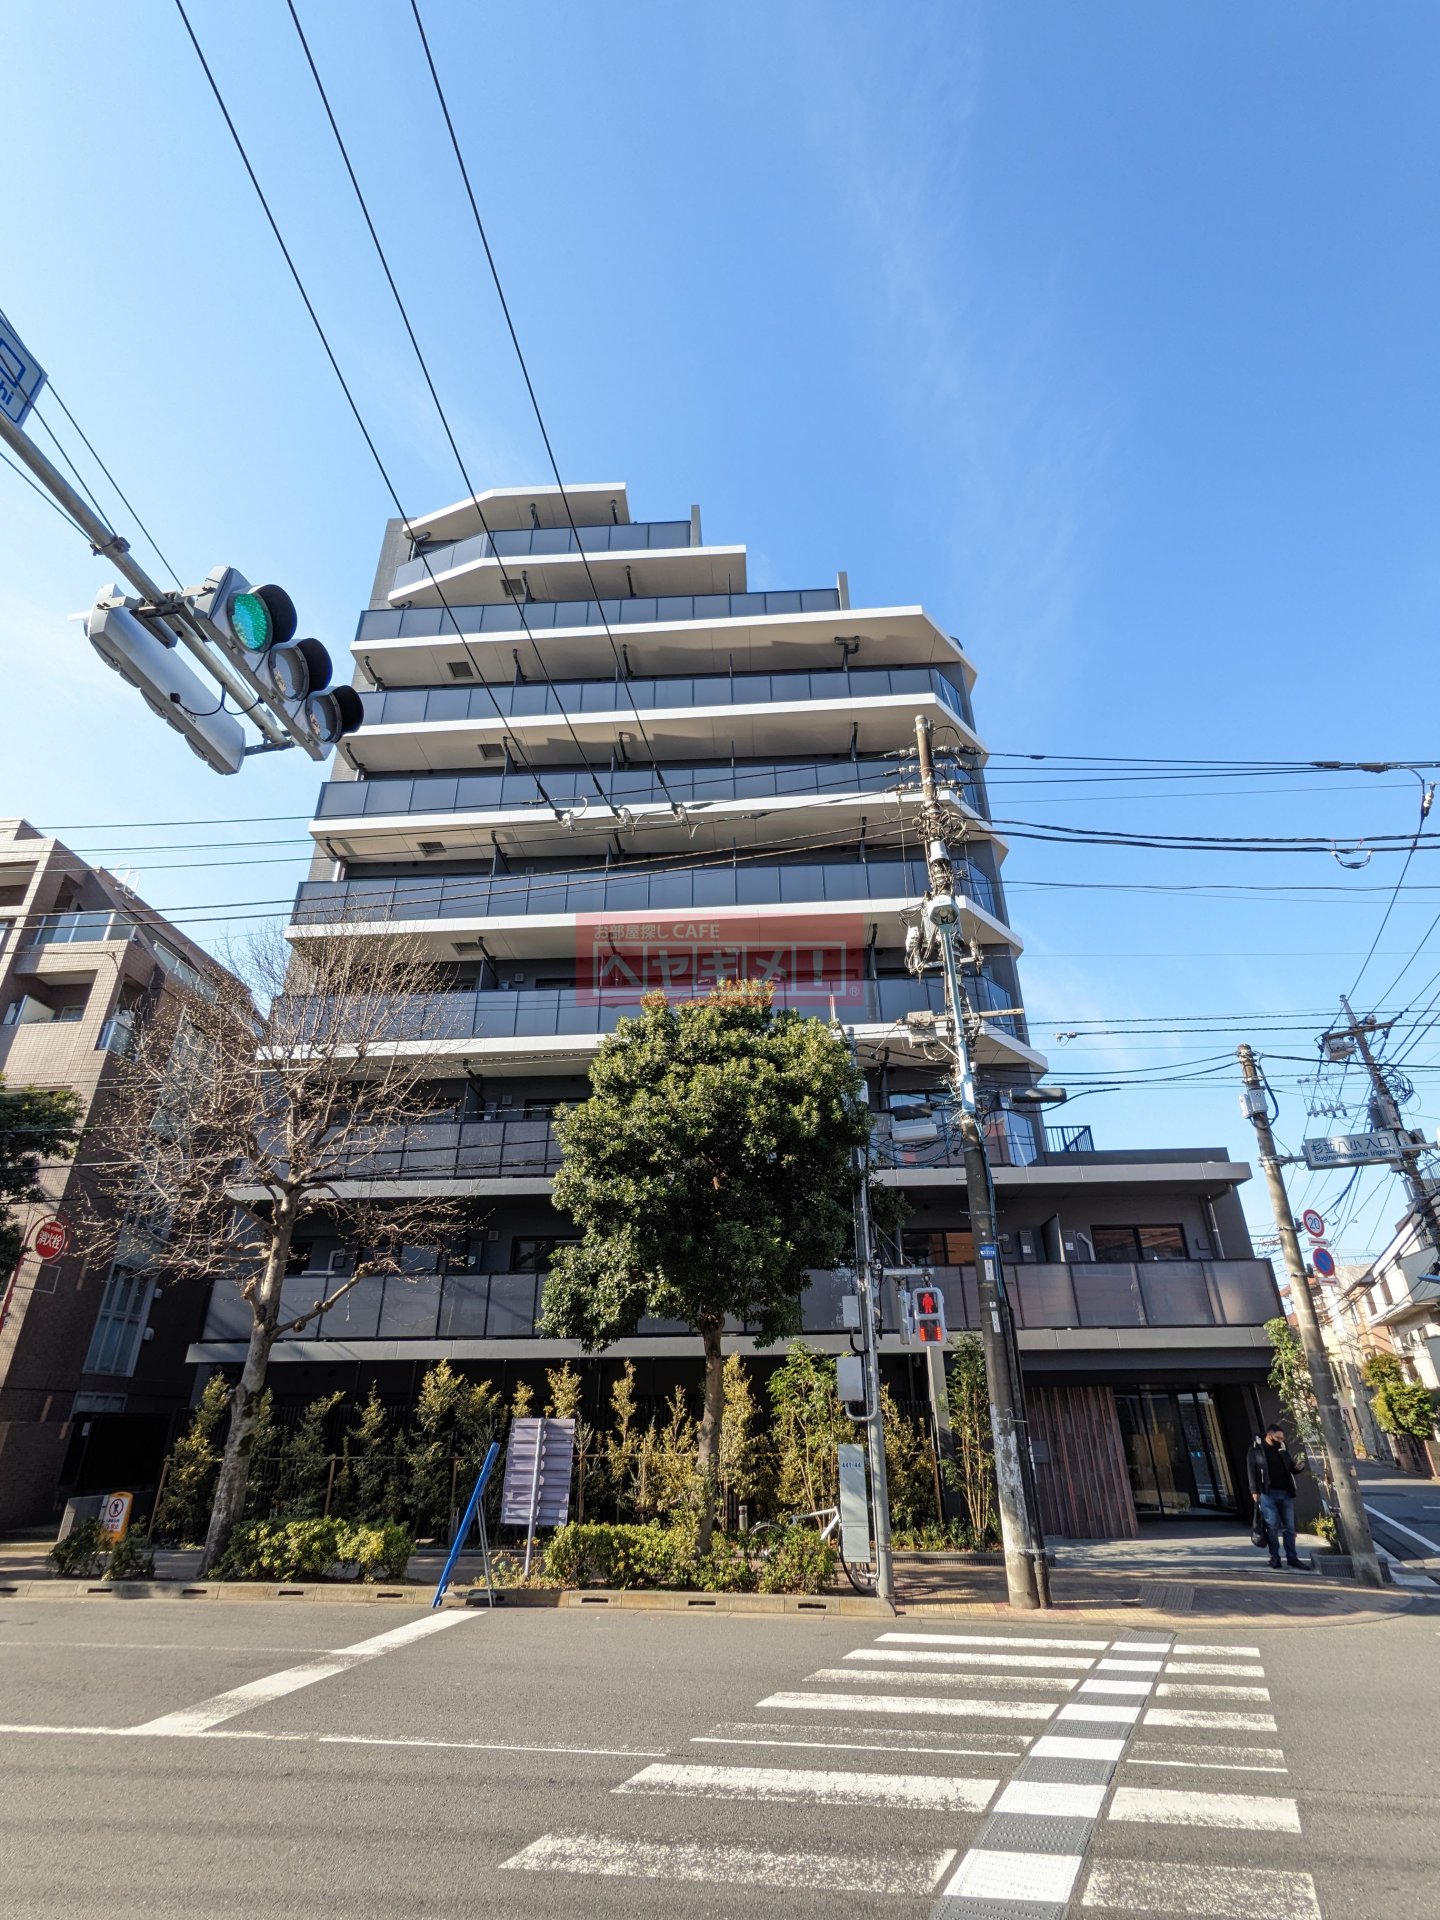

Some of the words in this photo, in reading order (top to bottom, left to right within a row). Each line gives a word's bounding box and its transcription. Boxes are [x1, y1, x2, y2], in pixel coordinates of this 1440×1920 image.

[1307, 1217, 1320, 1230] 20
[37, 1231, 62, 1249] 消火栓
